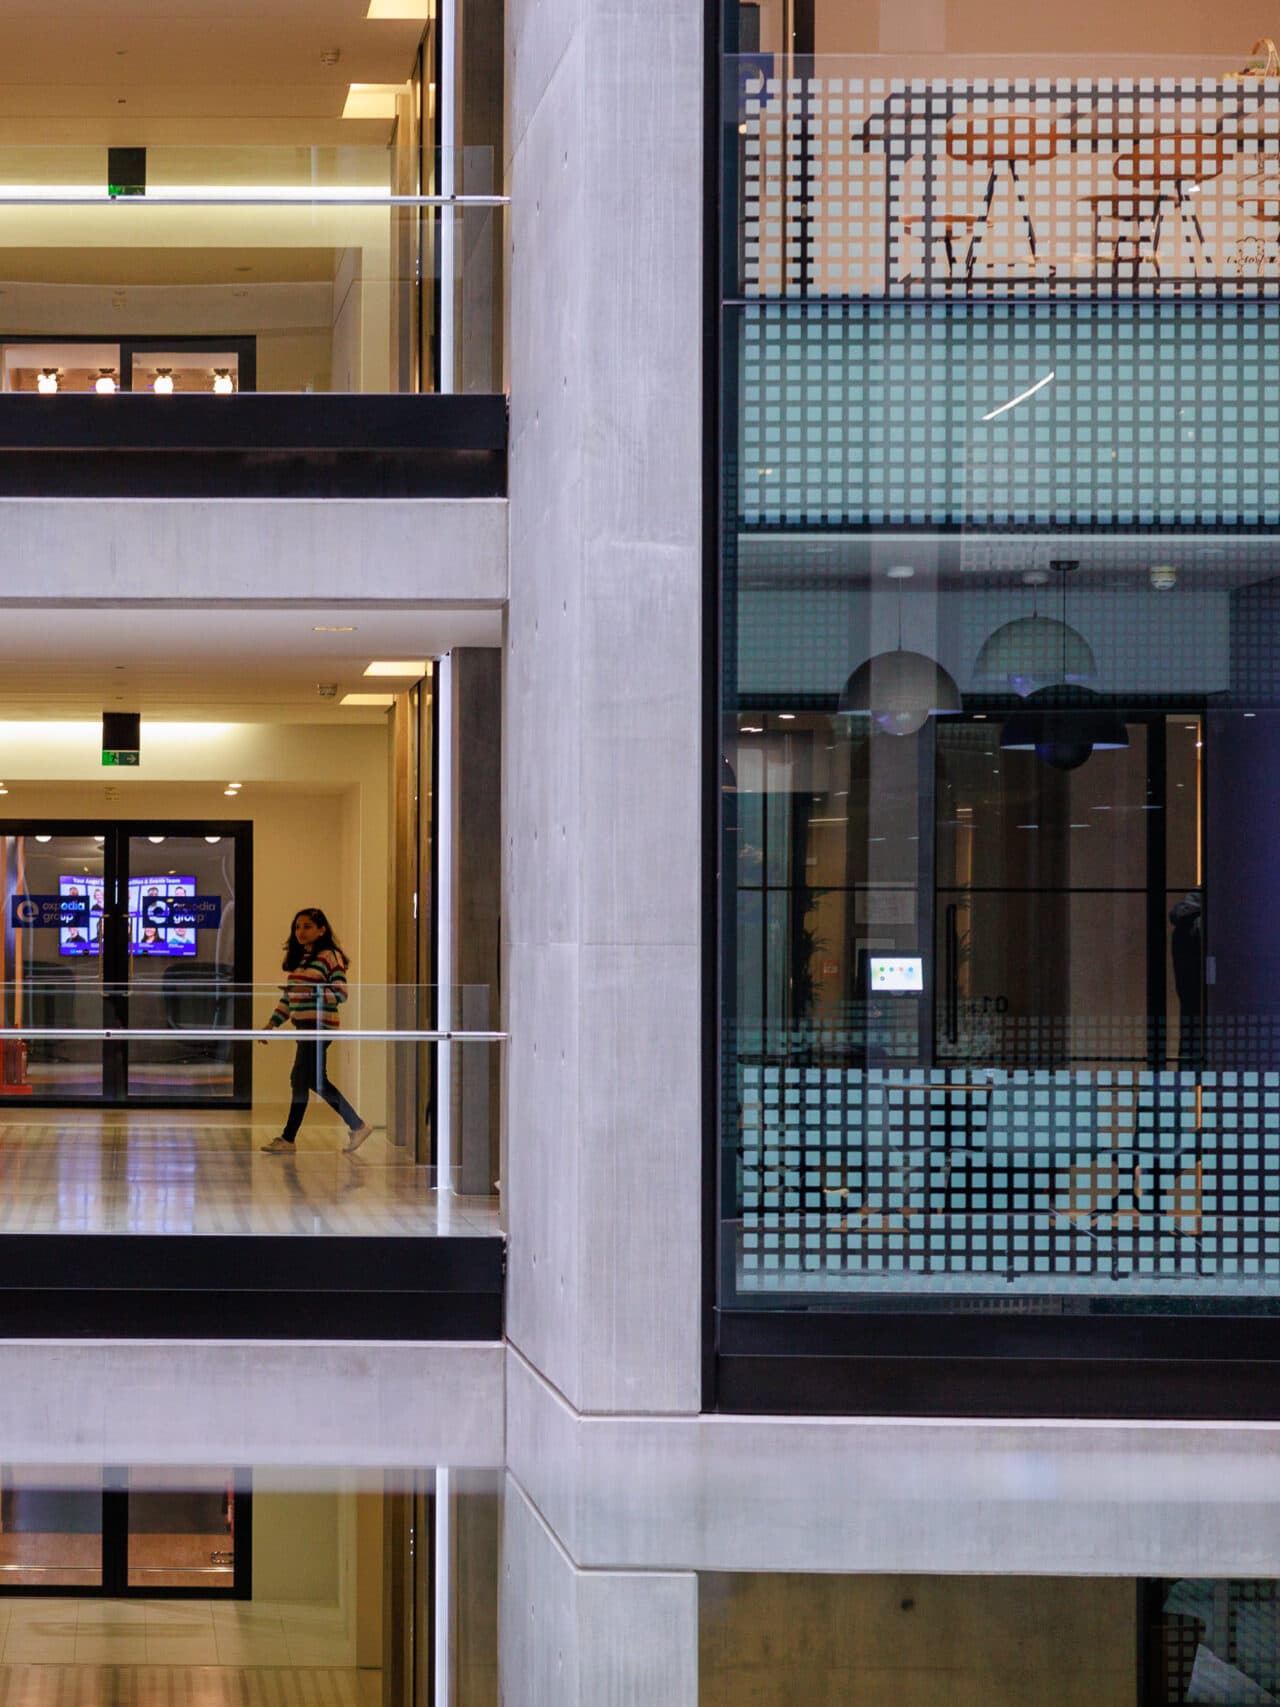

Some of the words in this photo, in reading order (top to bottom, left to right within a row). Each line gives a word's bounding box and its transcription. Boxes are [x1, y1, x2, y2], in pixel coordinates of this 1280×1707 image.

[42, 901, 86, 912] expedia
[173, 901, 216, 912] exedia
[42, 913, 74, 923] group
[173, 913, 205, 924] group
